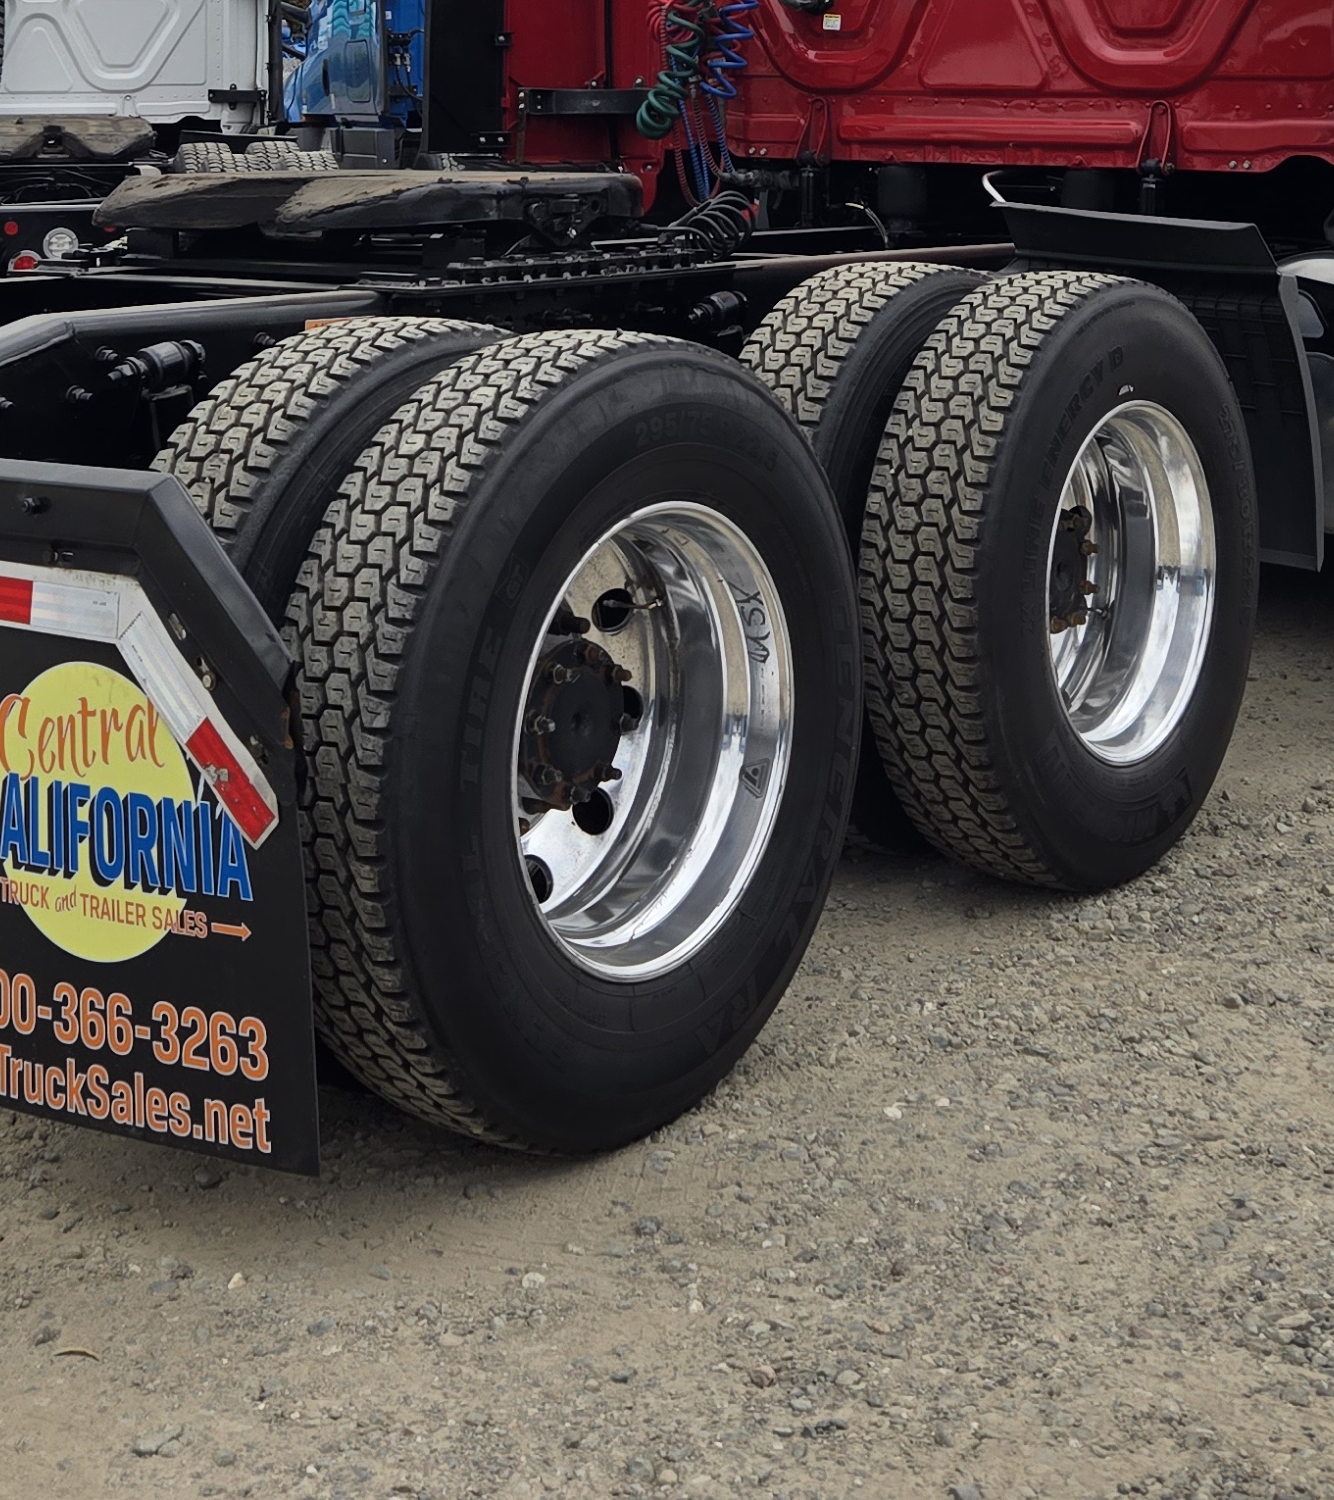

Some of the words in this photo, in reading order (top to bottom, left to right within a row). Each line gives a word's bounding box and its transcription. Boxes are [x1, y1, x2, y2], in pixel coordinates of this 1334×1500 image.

[0, 876, 51, 909] TRUCK
[55, 884, 78, 913] and
[79, 893, 148, 928] TRAILER
[151, 905, 209, 939] SALES
